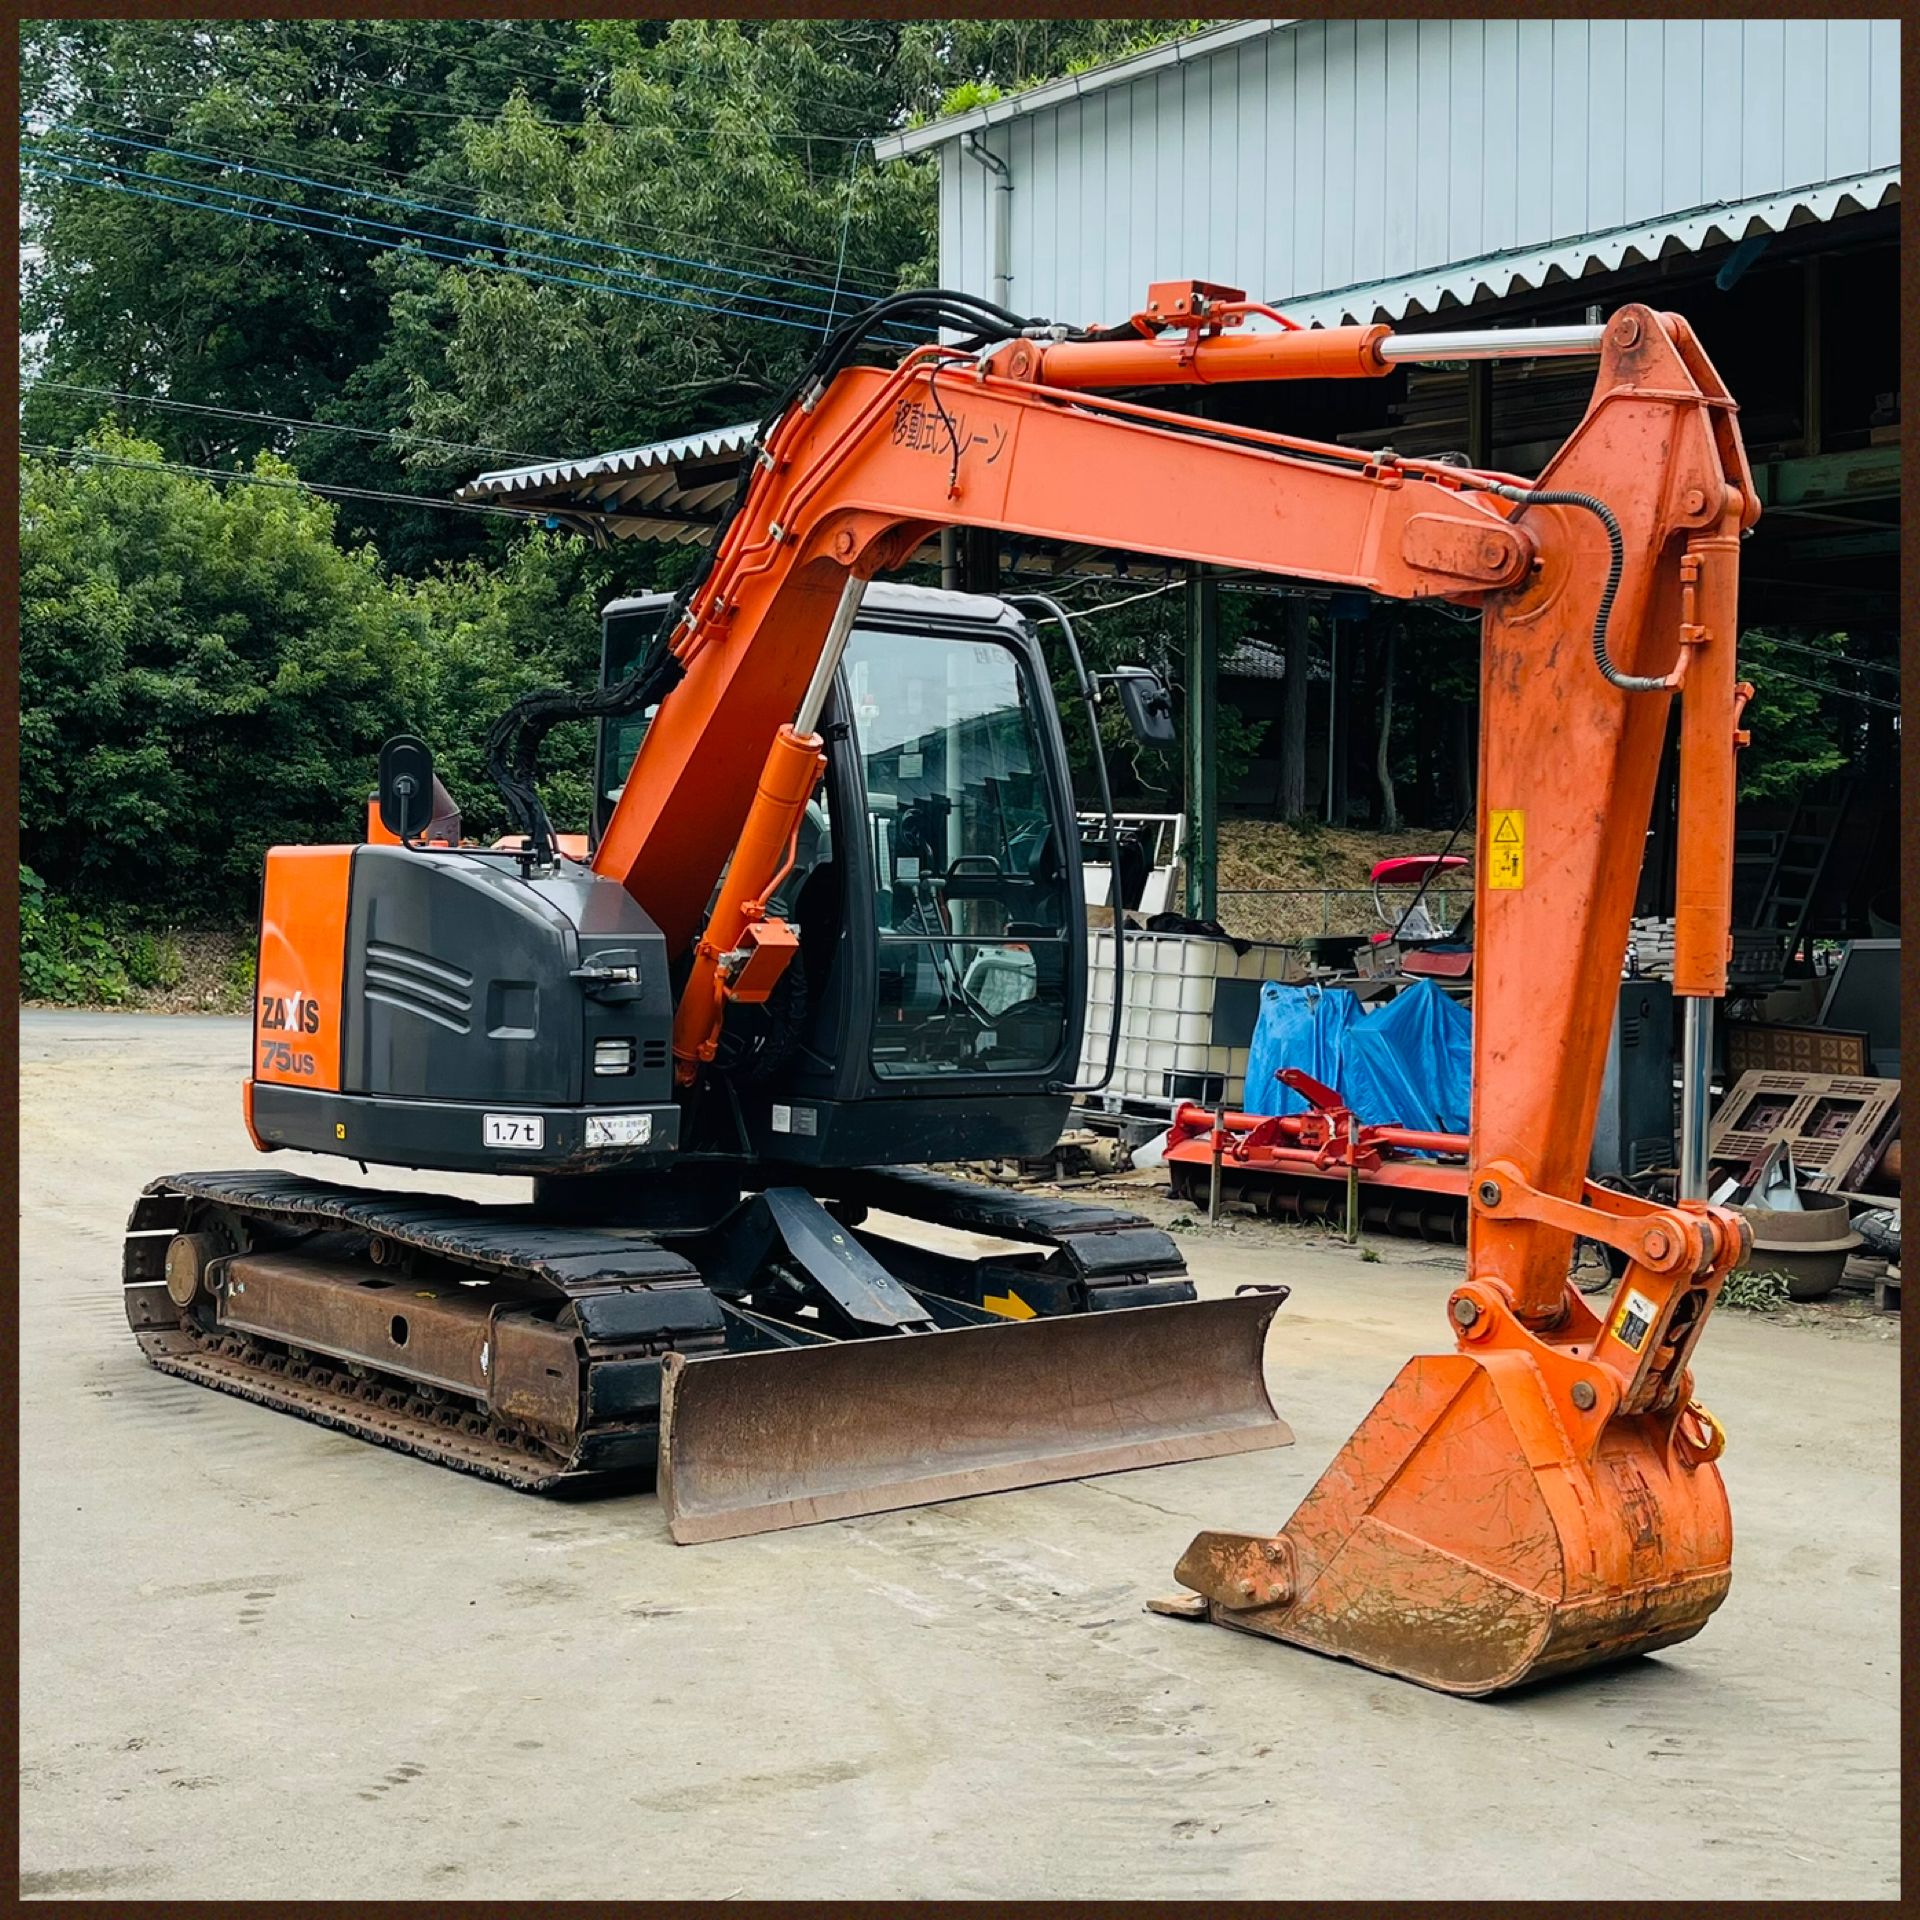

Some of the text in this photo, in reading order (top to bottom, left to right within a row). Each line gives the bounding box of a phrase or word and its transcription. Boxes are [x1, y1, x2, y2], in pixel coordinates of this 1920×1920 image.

[892, 399, 1008, 464] 移動式クレーン
[262, 991, 319, 1034] ZAXIS
